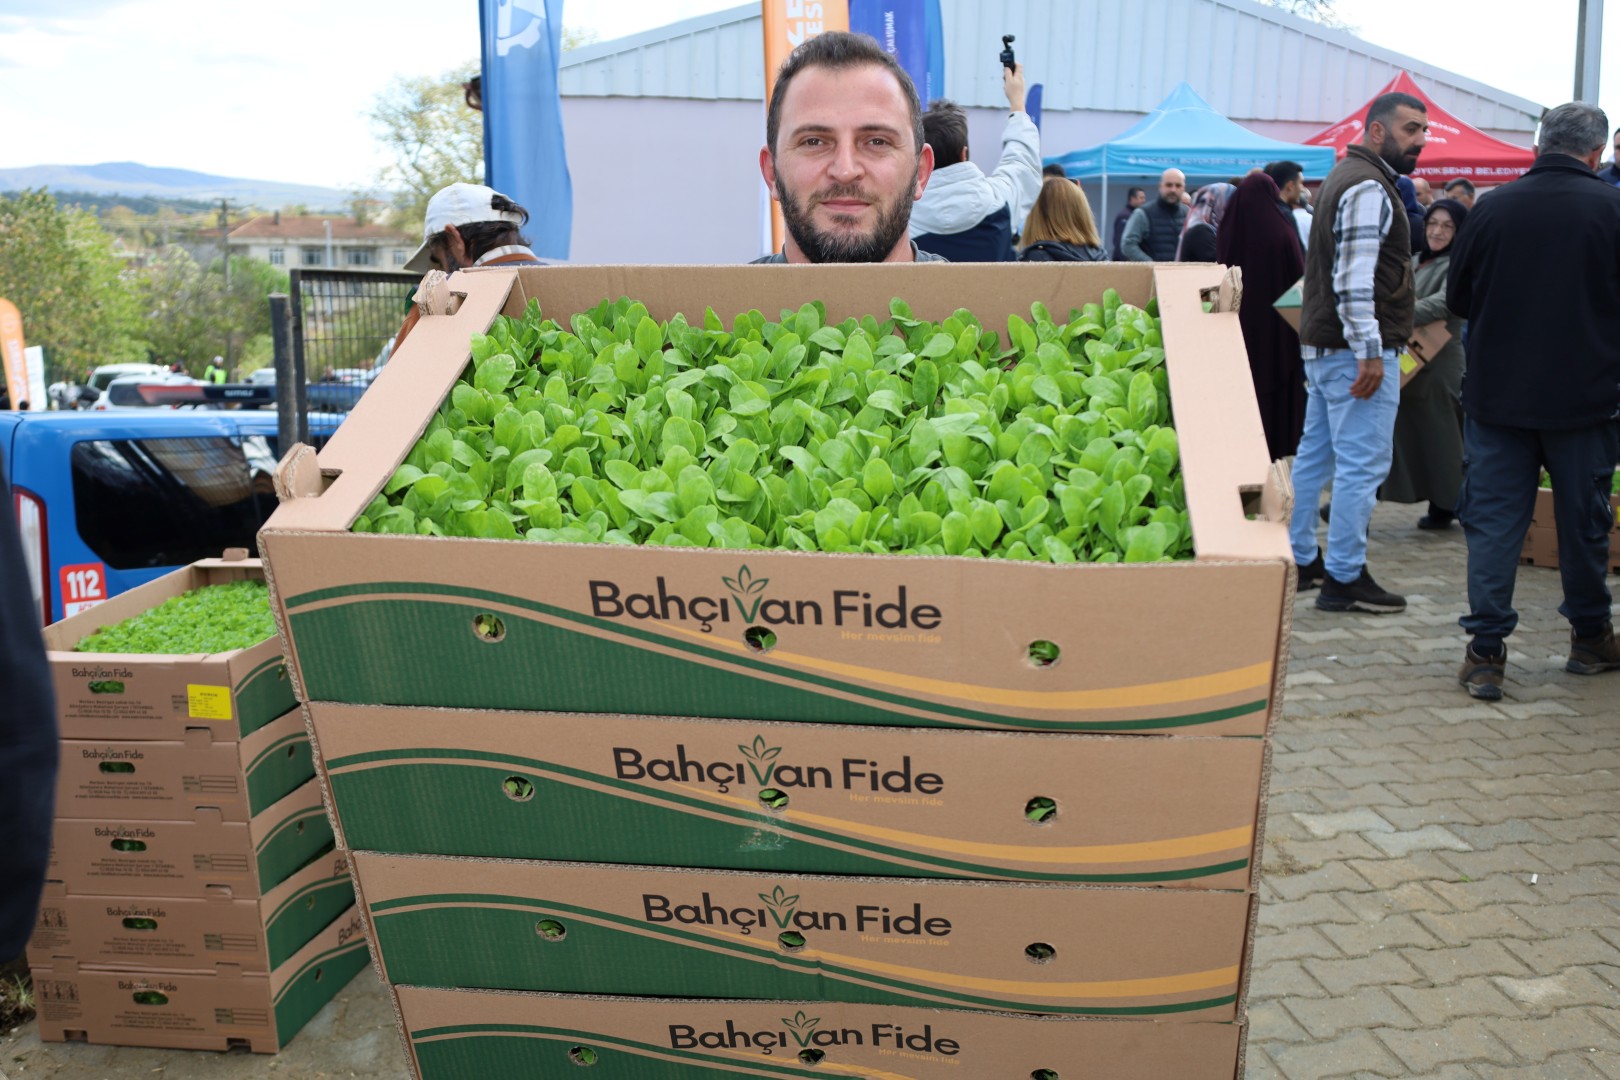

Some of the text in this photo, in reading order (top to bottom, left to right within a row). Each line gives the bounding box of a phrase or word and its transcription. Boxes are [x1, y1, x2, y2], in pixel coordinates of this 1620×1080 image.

[67, 569, 101, 600] 112
[833, 585, 942, 630] Fide
[841, 630, 941, 643] Her mevsim fide
[842, 756, 944, 794] Fide
[856, 903, 952, 937] Fide
[872, 1023, 960, 1055] Fide
